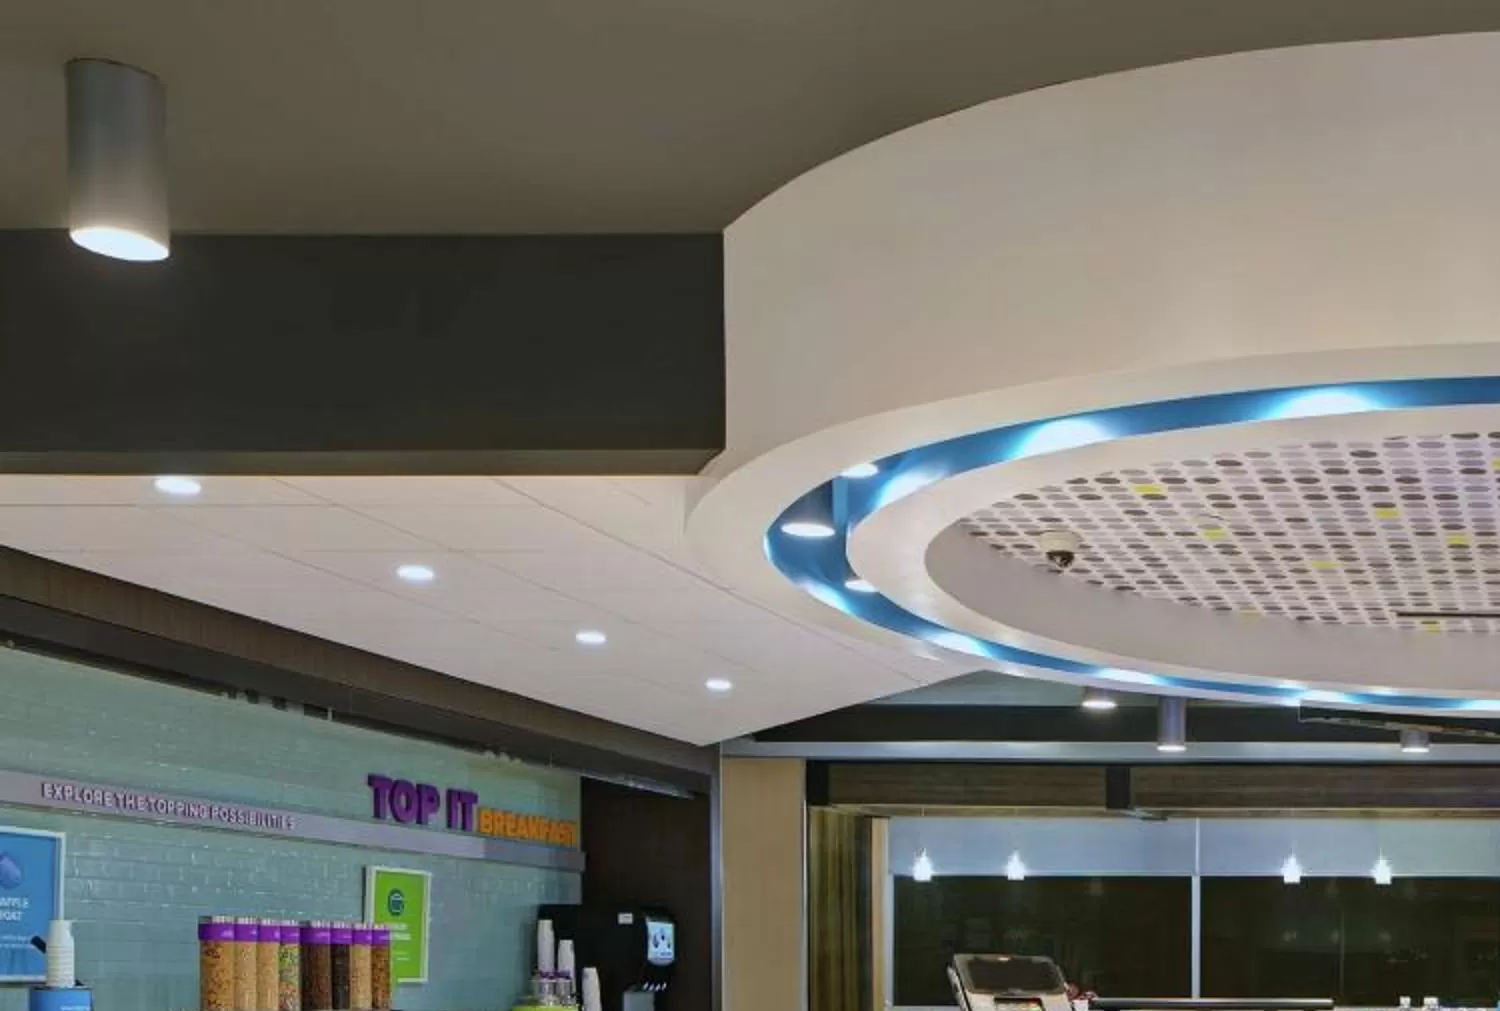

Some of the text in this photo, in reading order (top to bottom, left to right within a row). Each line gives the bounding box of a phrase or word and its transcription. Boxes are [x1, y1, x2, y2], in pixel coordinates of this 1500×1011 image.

[41, 782, 297, 832] EXPLORE THE TOPPING POSSIBILITIES
[367, 772, 578, 845] TOP IT BREAKFAST
